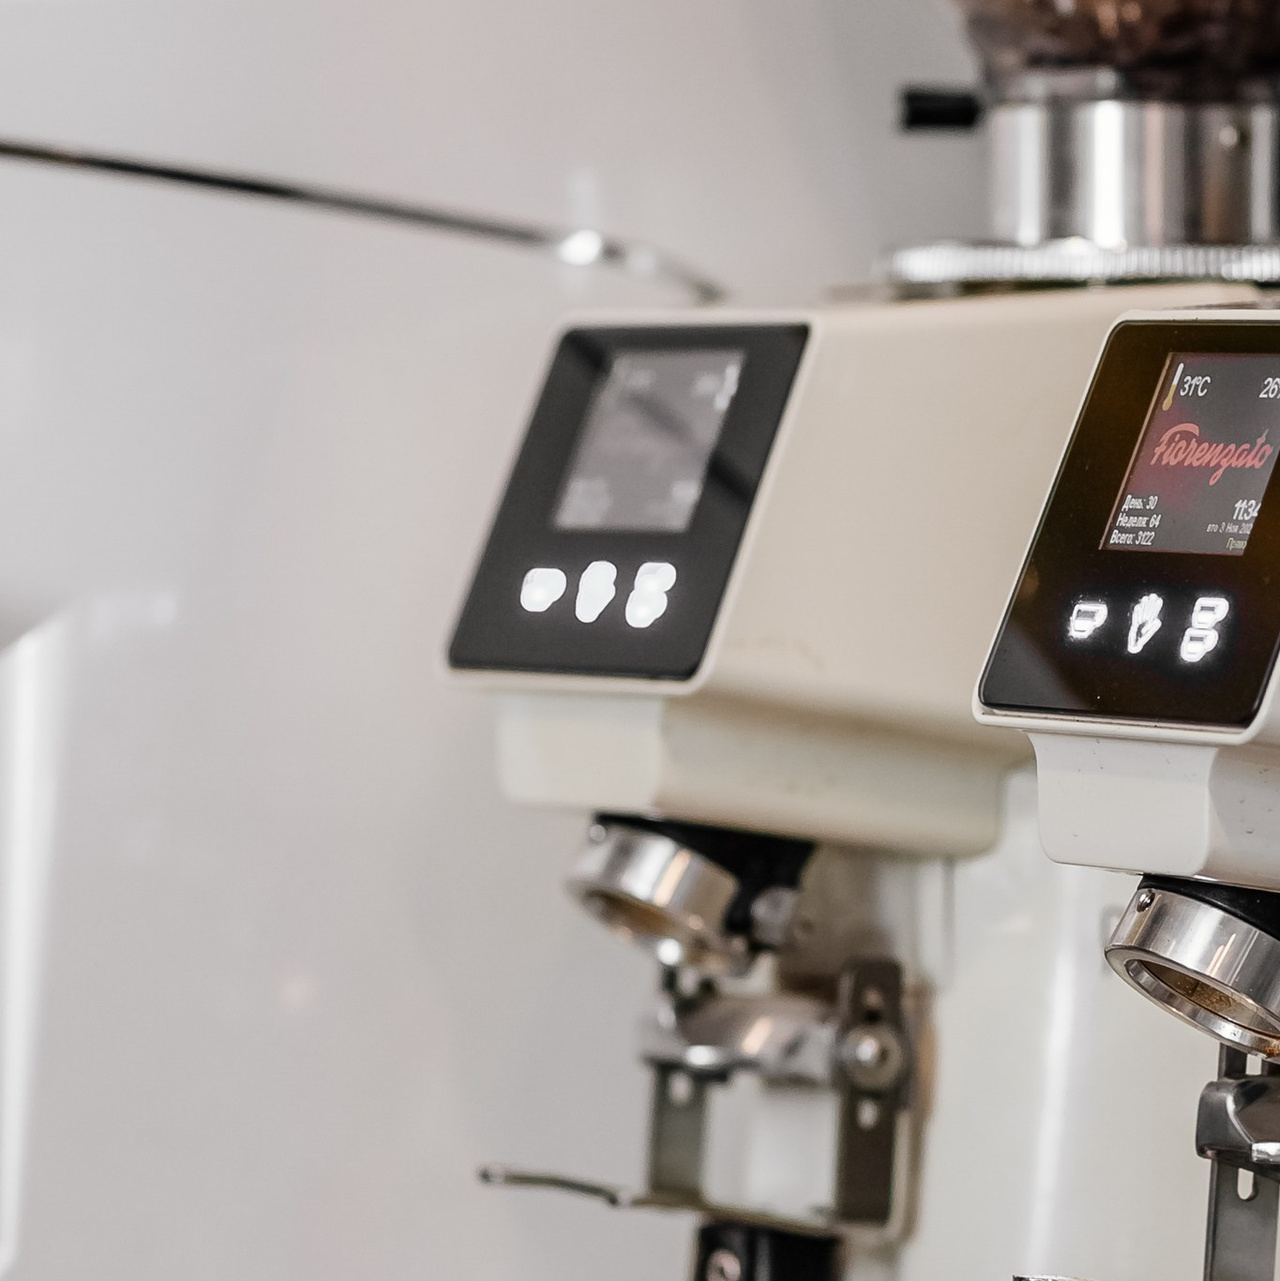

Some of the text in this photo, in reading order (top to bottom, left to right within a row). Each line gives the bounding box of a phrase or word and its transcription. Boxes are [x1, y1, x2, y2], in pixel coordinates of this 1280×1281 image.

[1150, 423, 1274, 486] Fiorenzato
[1146, 495, 1159, 510] 30
[1149, 513, 1162, 528] 64
[1135, 530, 1156, 546] 3122
